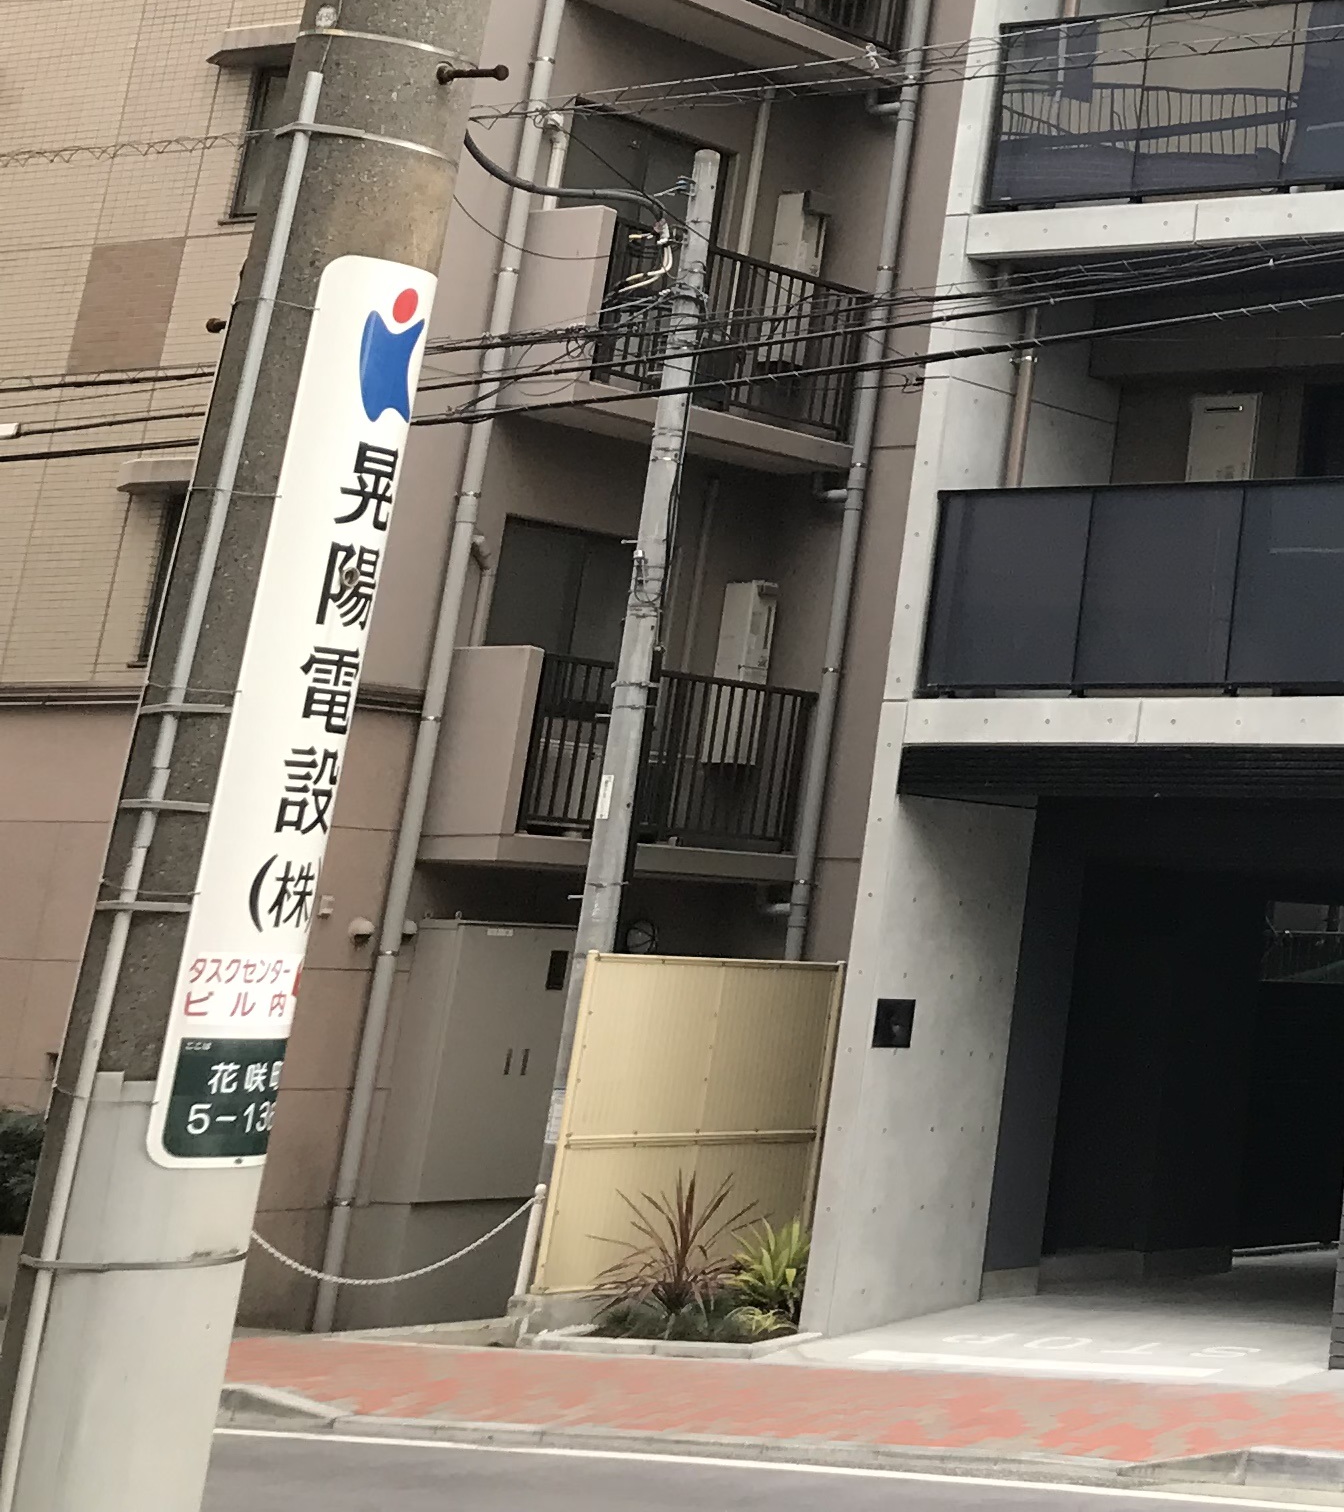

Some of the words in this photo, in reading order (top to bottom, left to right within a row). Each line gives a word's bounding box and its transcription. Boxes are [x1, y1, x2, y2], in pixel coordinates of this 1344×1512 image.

[188, 958, 290, 984] タスクセンター
[184, 991, 287, 1018] ビル内
[942, 1333, 1261, 1358] STOP
